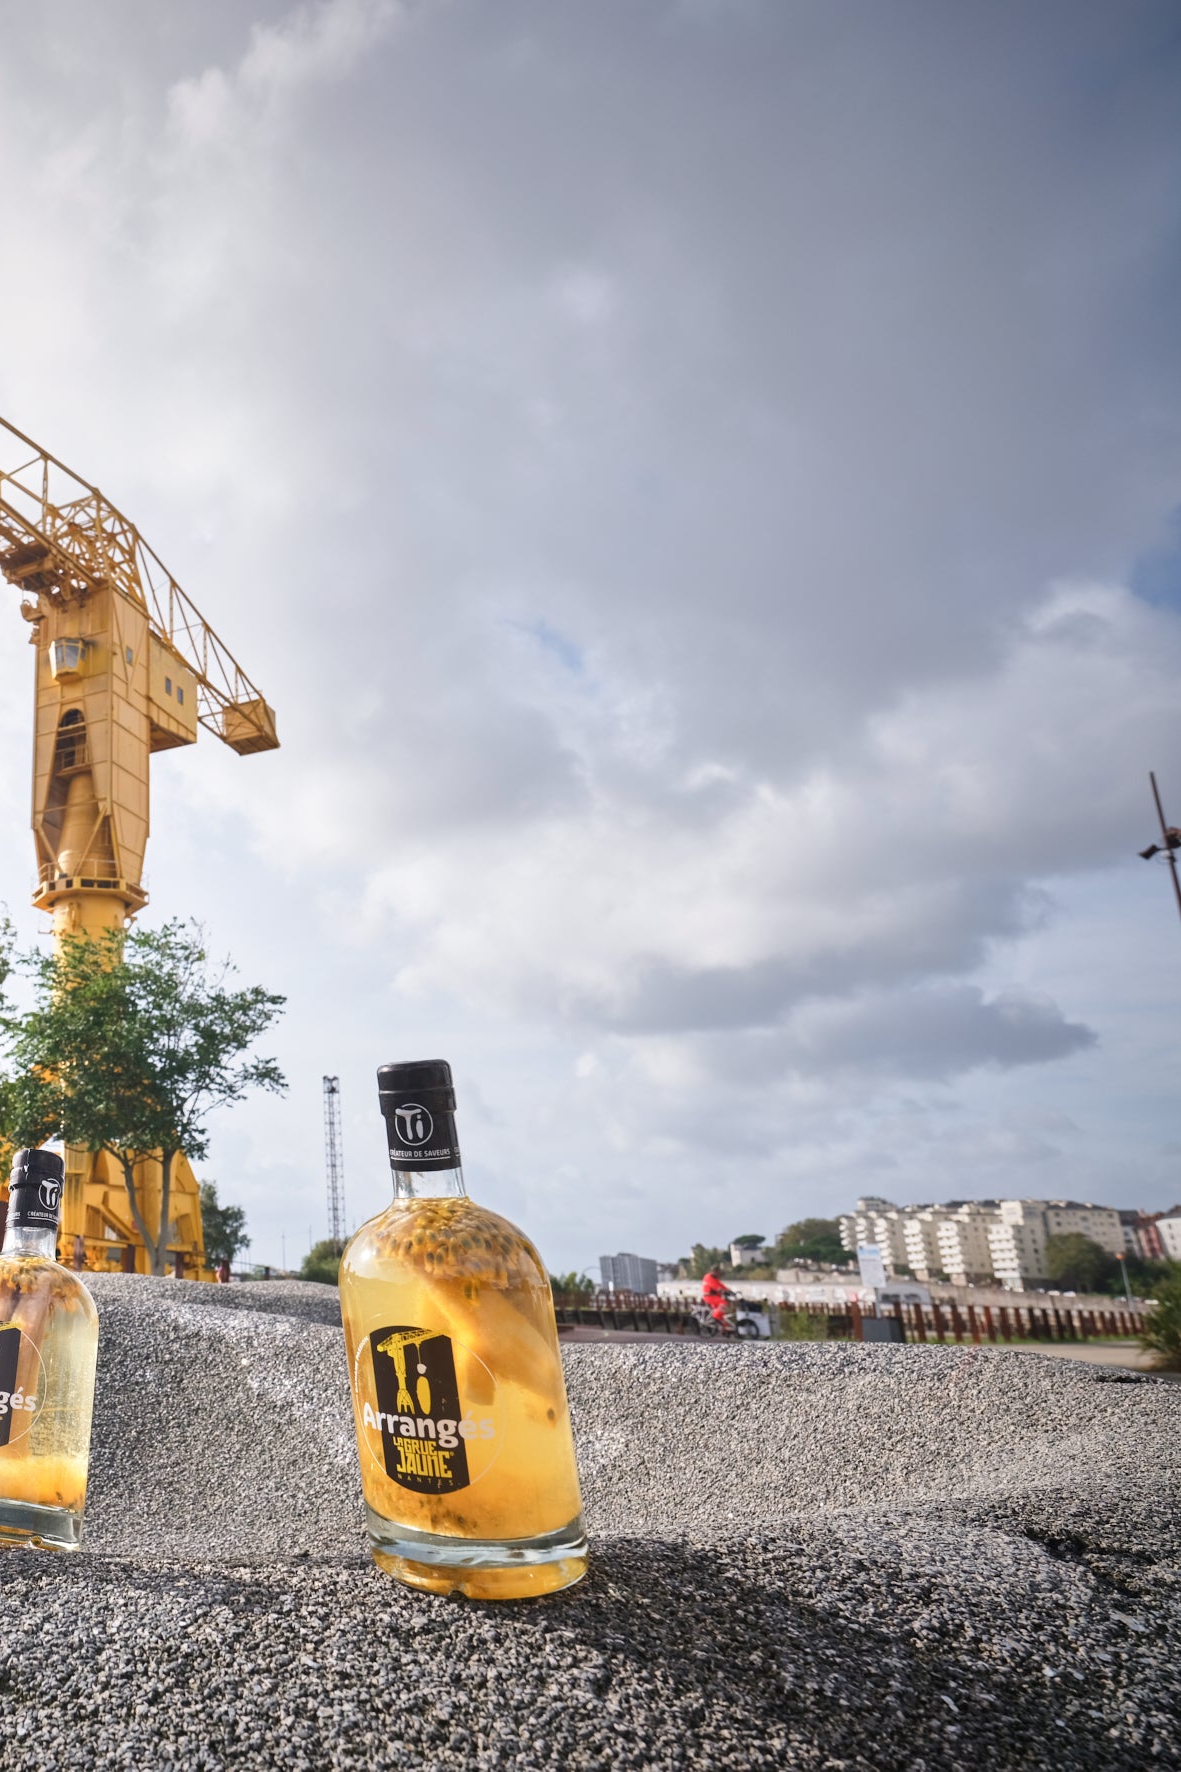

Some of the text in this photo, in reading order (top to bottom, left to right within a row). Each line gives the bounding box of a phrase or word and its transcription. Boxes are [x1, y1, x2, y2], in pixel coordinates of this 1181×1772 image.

[424, 1148, 451, 1157] SAVEURS
[363, 1402, 497, 1449] Arrangés
[393, 1436, 438, 1456] LA GRUE
